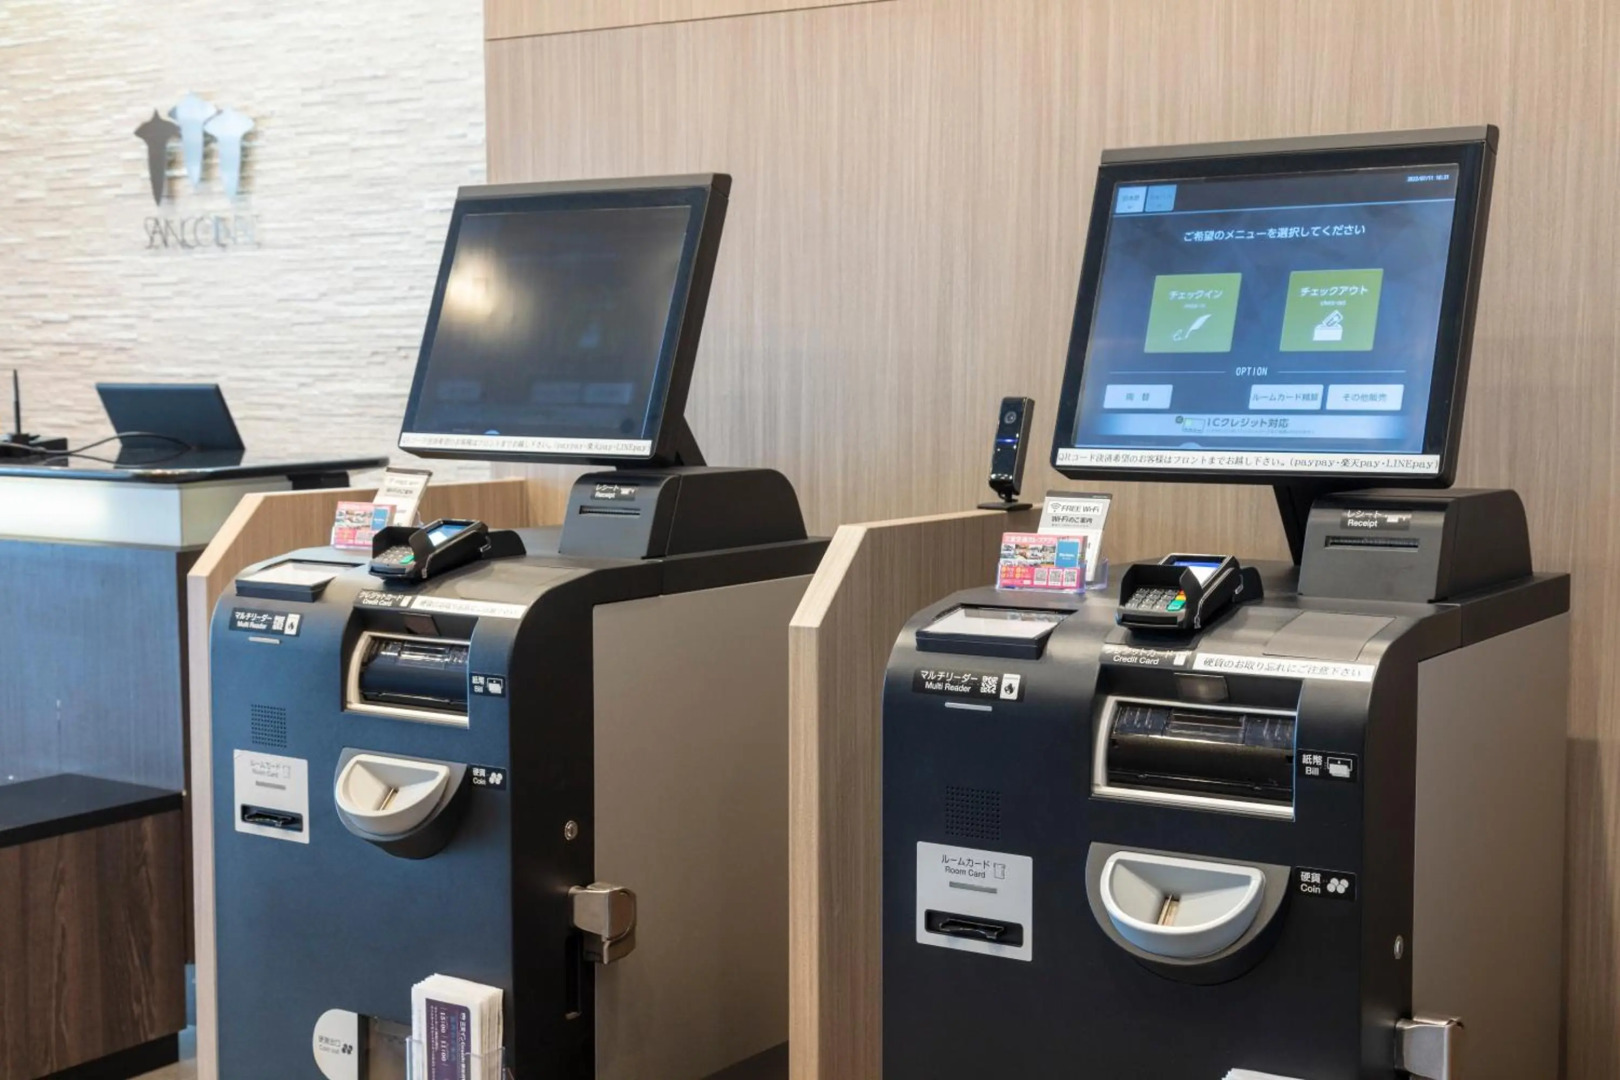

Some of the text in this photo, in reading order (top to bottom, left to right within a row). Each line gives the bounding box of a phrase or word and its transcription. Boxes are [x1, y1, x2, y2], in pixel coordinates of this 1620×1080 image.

[1183, 225, 1366, 242] ご希望のメニューを選択してください
[1168, 290, 1224, 301] チェックイン
[1300, 286, 1369, 297] チェックアウト
[1235, 366, 1268, 377] OPTION
[1207, 417, 1290, 429] ICクレジット対応
[1060, 504, 1100, 513] FREE Wi-Fi
[1346, 510, 1382, 519] レシート
[1347, 519, 1378, 529] Receipt
[1112, 655, 1160, 665] Credit Card
[920, 670, 979, 683] マルチリーダー
[924, 681, 972, 693] Multi Reader
[1301, 753, 1323, 766] 紙幣
[1305, 766, 1320, 776] Bill
[941, 854, 991, 869] ルームカード
[944, 865, 986, 879] Room Card
[1300, 871, 1321, 884] 硬貨
[1300, 883, 1321, 894] Coin
